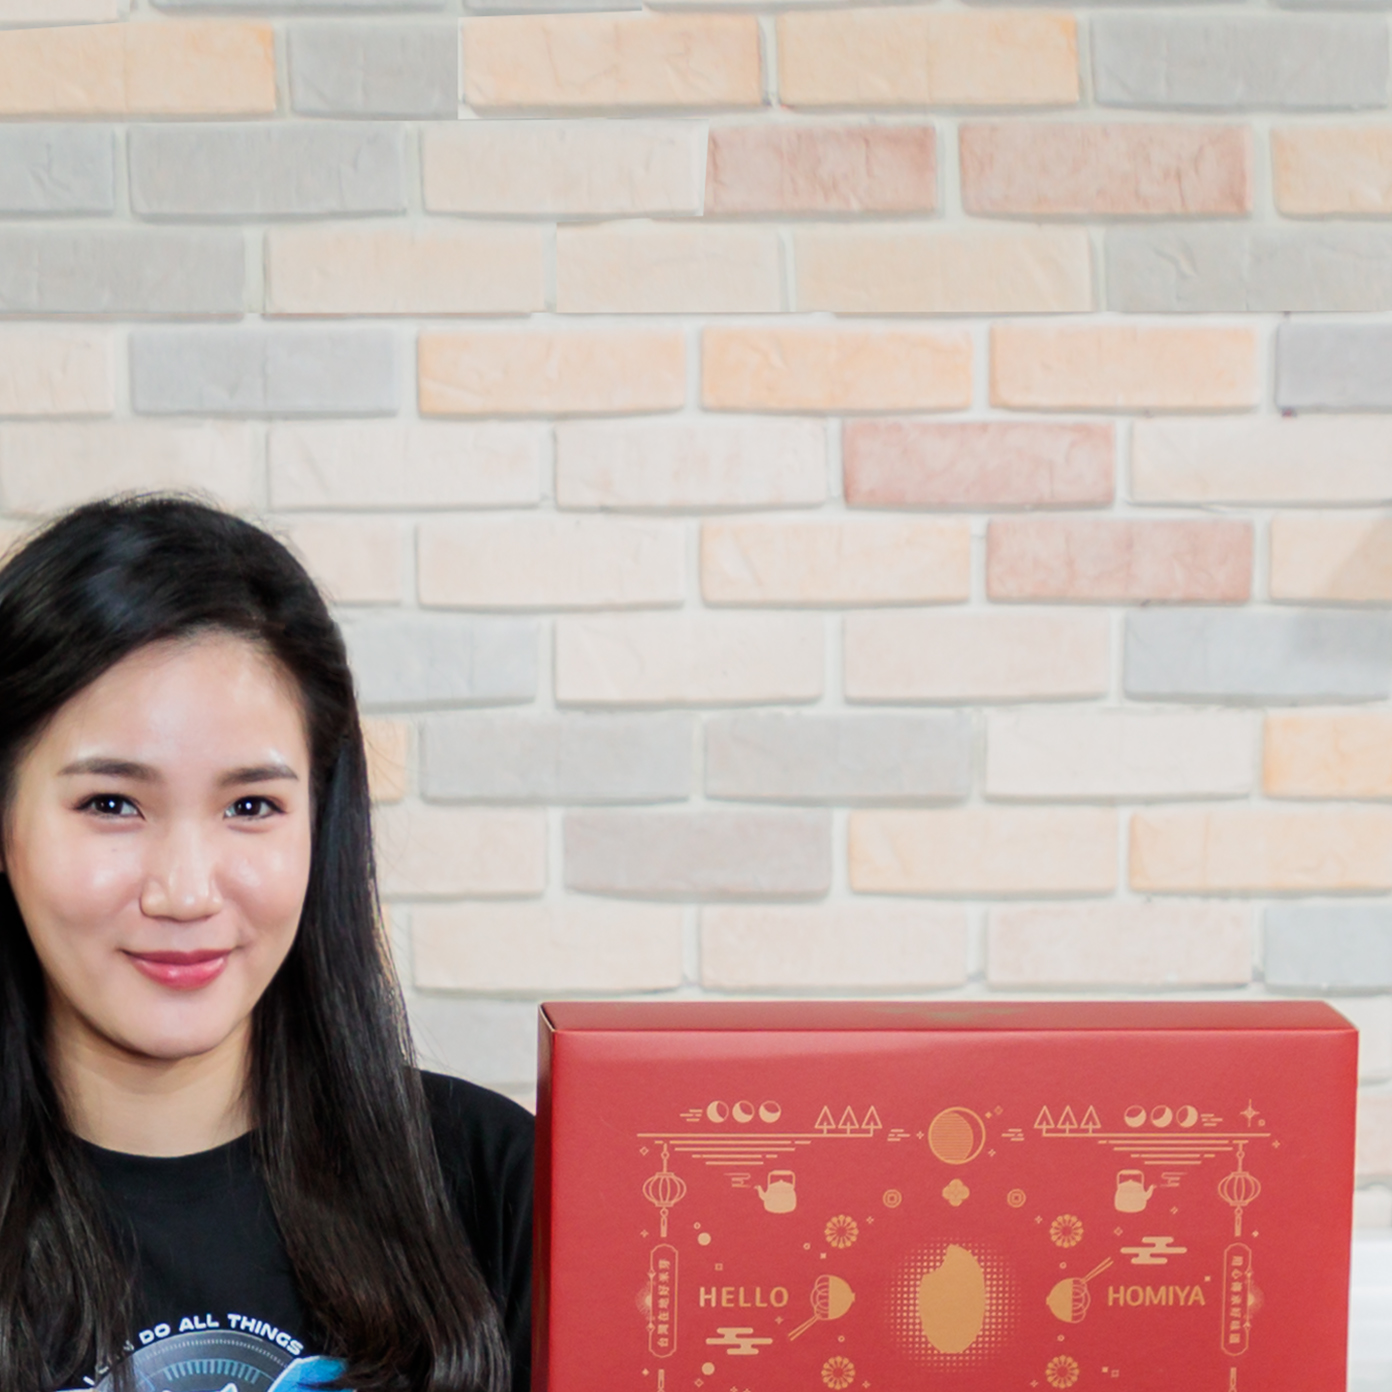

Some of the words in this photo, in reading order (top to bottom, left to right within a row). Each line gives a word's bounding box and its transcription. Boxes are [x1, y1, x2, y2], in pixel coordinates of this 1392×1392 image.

[699, 1286, 789, 1308] HELLO
[1108, 1285, 1206, 1307] HOMIYA
[138, 1322, 172, 1345] DO
[179, 1313, 219, 1330] ALL
[227, 1313, 305, 1356] THINGS
